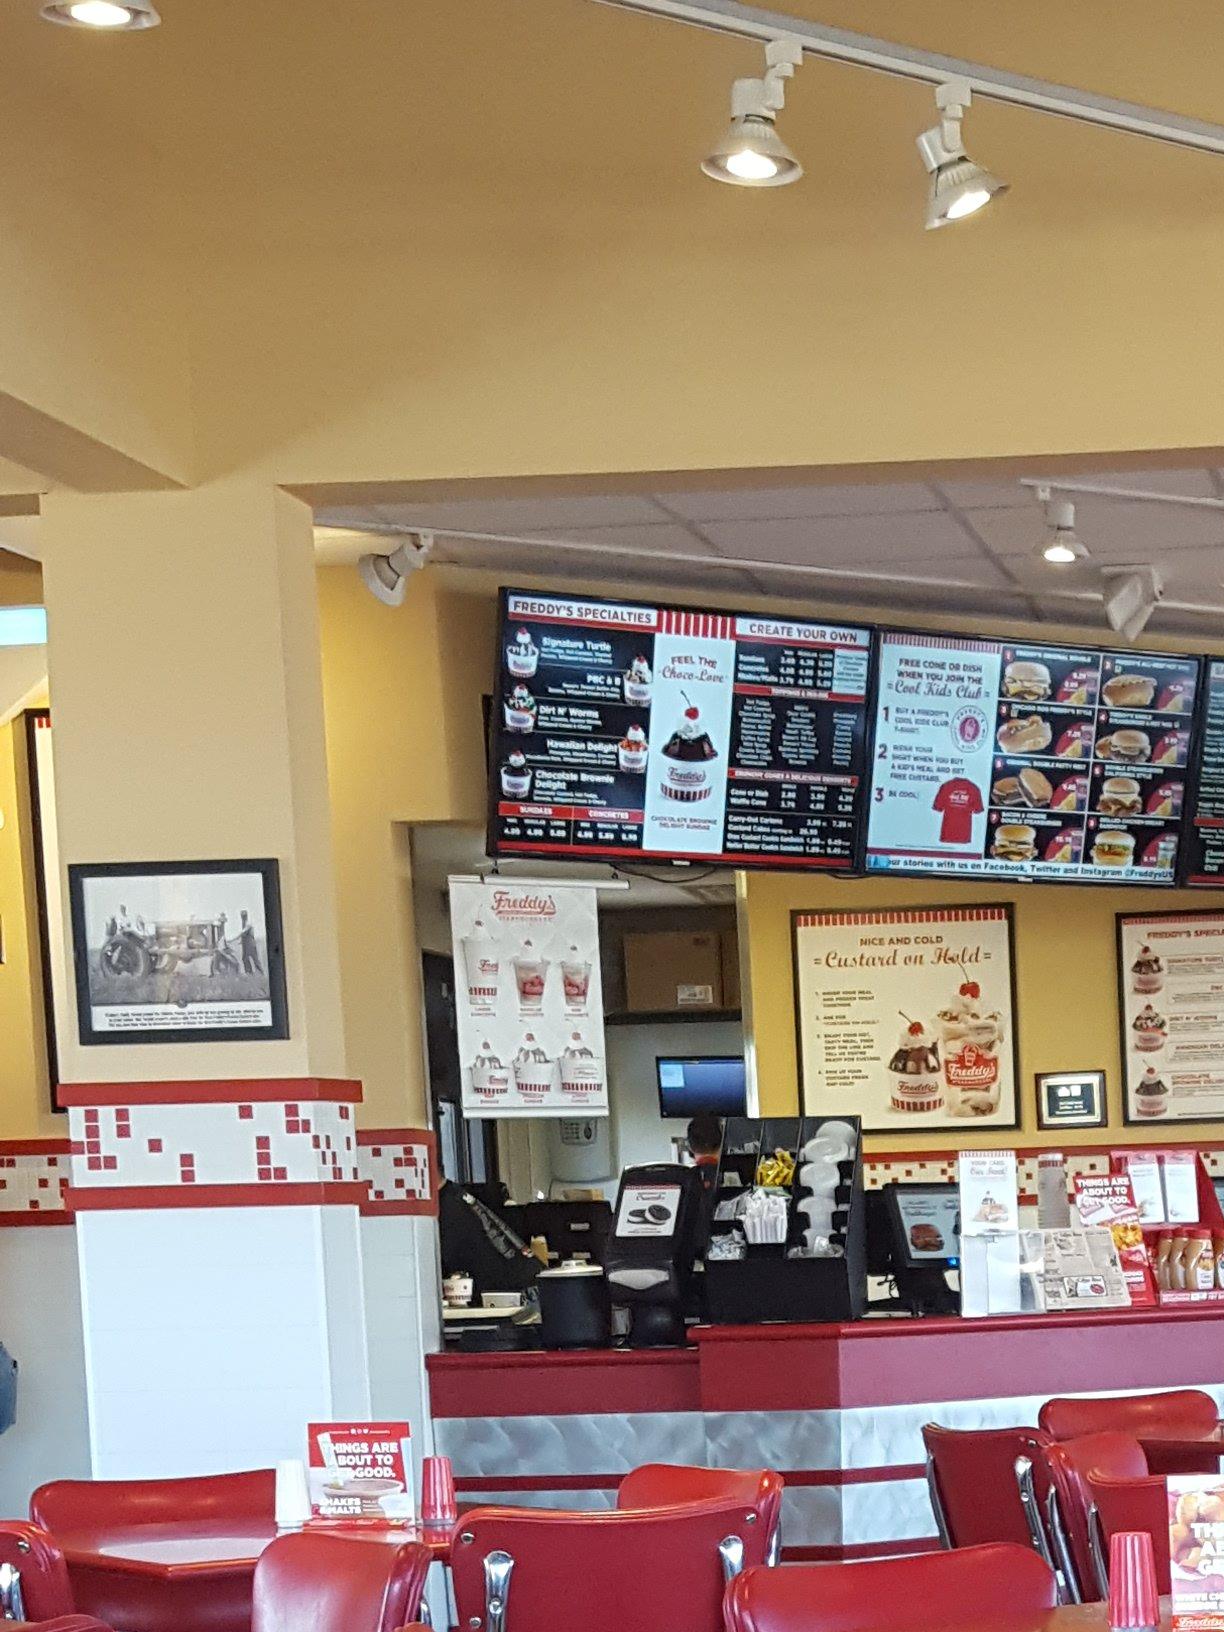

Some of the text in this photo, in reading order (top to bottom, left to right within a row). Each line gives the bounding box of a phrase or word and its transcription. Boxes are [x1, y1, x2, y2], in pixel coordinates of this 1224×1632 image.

[513, 600, 652, 624] FREDDY'S SPECIALTIES
[750, 624, 858, 643] CREATE YOUR OWN
[671, 656, 718, 669] FEEL THE
[898, 658, 983, 673] FREE CONE OR DISH
[662, 666, 724, 683] Choco-Love
[896, 669, 984, 686] WHEN YOU JOIN THE
[894, 680, 983, 700] Cool Kids Club
[882, 706, 890, 722] 1
[878, 743, 889, 760] 2
[874, 787, 885, 803] 3
[903, 860, 934, 868] stories
[936, 860, 956, 869] with
[958, 862, 969, 870] us
[983, 862, 1028, 873] Facebook,
[1063, 865, 1079, 875] and
[1081, 866, 1123, 877] Instagram
[491, 890, 557, 917] Freddy's
[860, 935, 944, 947] NICE AND COLD
[1147, 929, 1192, 939] FREDDY'S
[825, 946, 981, 969] Custard on Hold
[948, 1062, 996, 1082] Freddy's
[896, 1080, 939, 1095] Freddy's
[1075, 1177, 1131, 1189] THINGS ARE
[1082, 1186, 1128, 1198] ABOUT TO
[371, 1442, 399, 1453] ARE
[337, 1454, 394, 1466] BOUT TO
[354, 1466, 396, 1478] GOOD.
